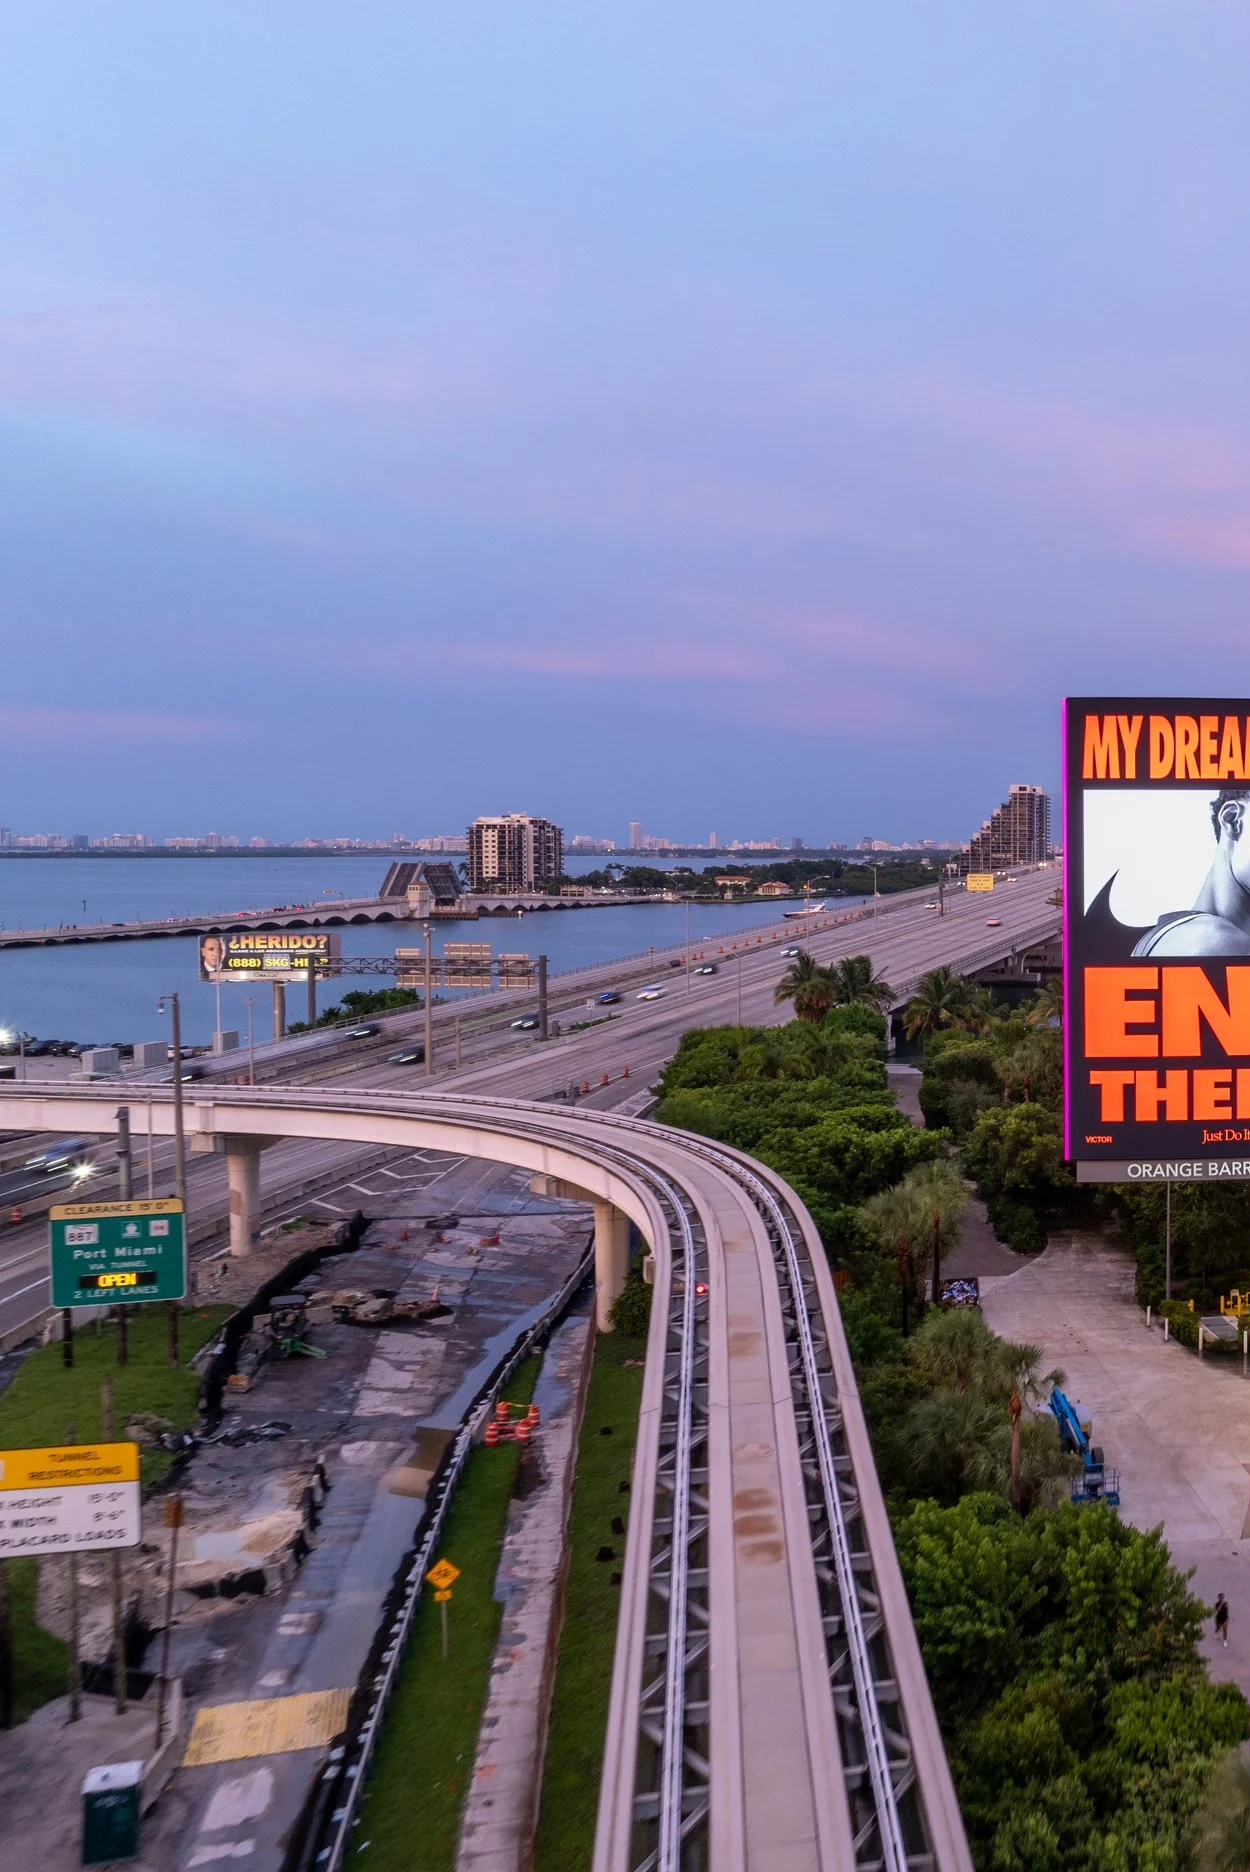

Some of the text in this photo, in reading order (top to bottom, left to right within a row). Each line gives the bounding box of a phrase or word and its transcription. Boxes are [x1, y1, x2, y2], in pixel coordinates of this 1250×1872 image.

[1082, 715, 1143, 779] MY
[228, 935, 328, 949] ¿HERIDO?
[228, 958, 261, 968] (888)
[1202, 1129, 1223, 1144] Just
[1225, 1129, 1242, 1140] Do
[1127, 1163, 1203, 1178] ORANGE
[64, 1203, 133, 1215] CLEARANCE
[68, 1231, 93, 1242] 887
[73, 1244, 163, 1260] Port Miami
[98, 1273, 137, 1287] OPEN
[73, 1285, 159, 1299] 2 LEFT LANES
[48, 1451, 102, 1462] TUNNEL
[28, 1465, 123, 1480] RESTRICTIONS
[75, 1528, 127, 1542] LOADS
